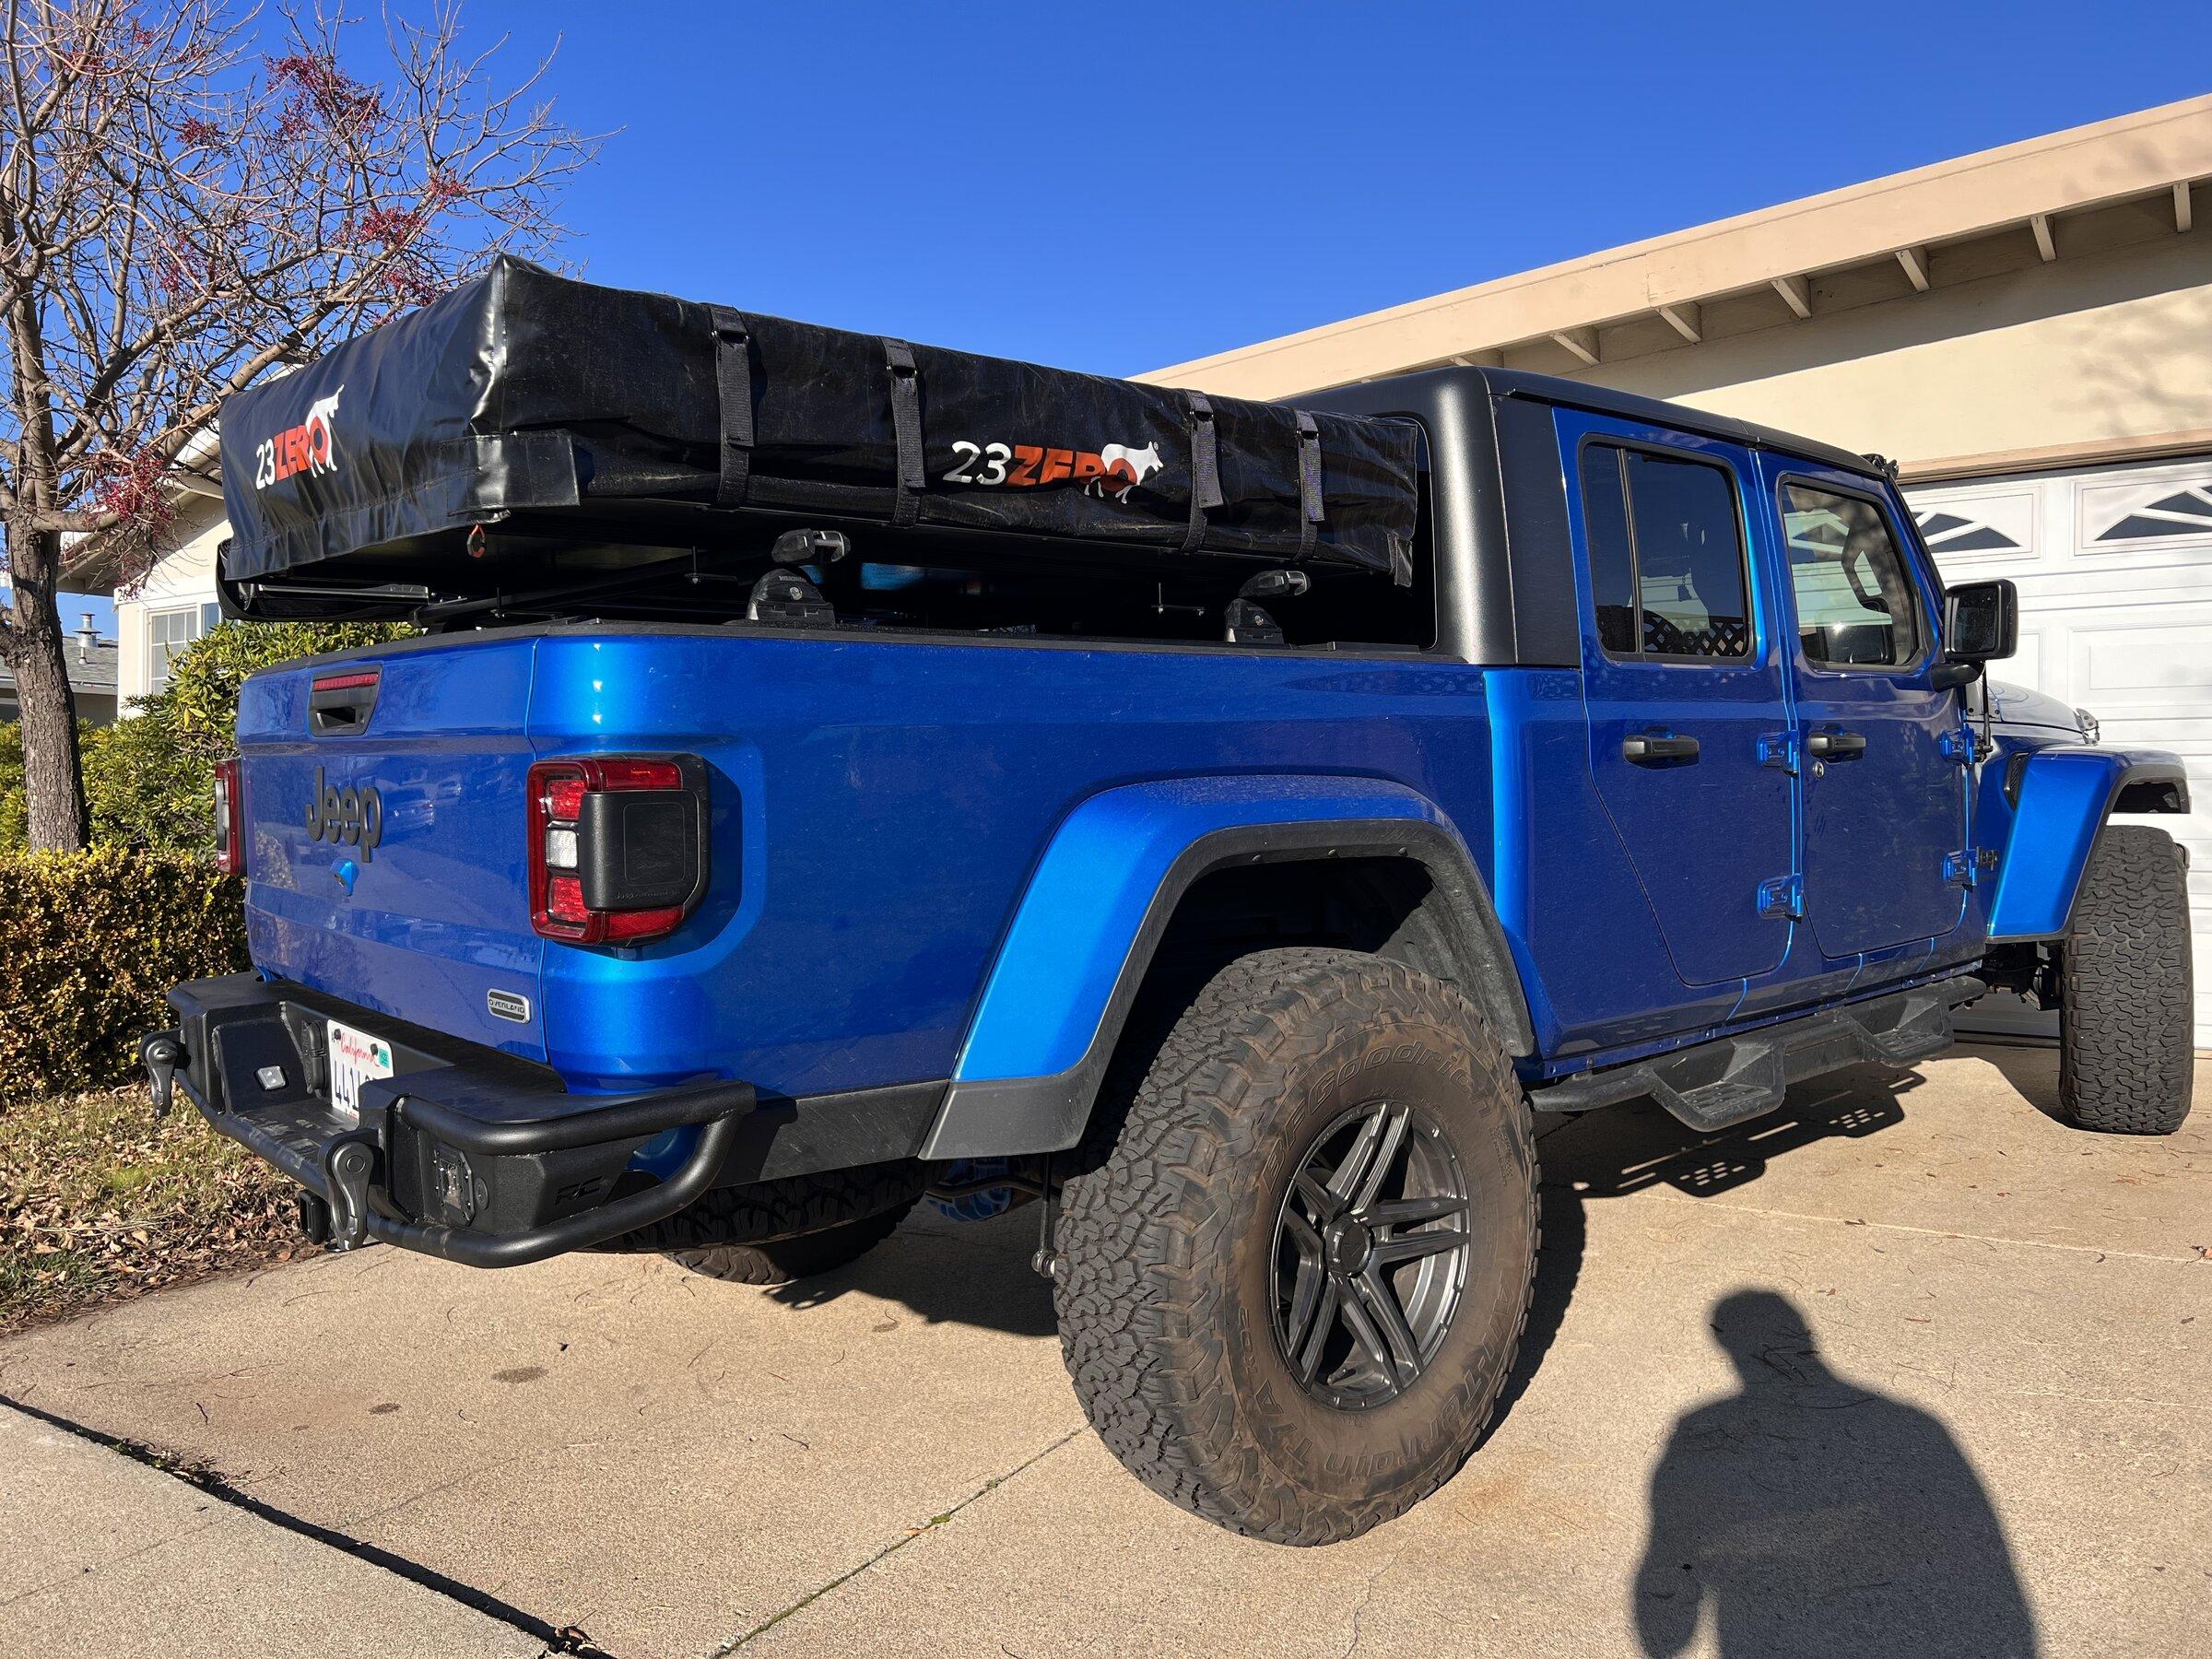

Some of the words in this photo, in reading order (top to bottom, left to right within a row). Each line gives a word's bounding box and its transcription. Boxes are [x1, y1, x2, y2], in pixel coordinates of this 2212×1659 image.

[255, 416, 329, 490] 23ZERO
[942, 441, 1139, 493] 23ZERO
[305, 766, 382, 864] Jeep
